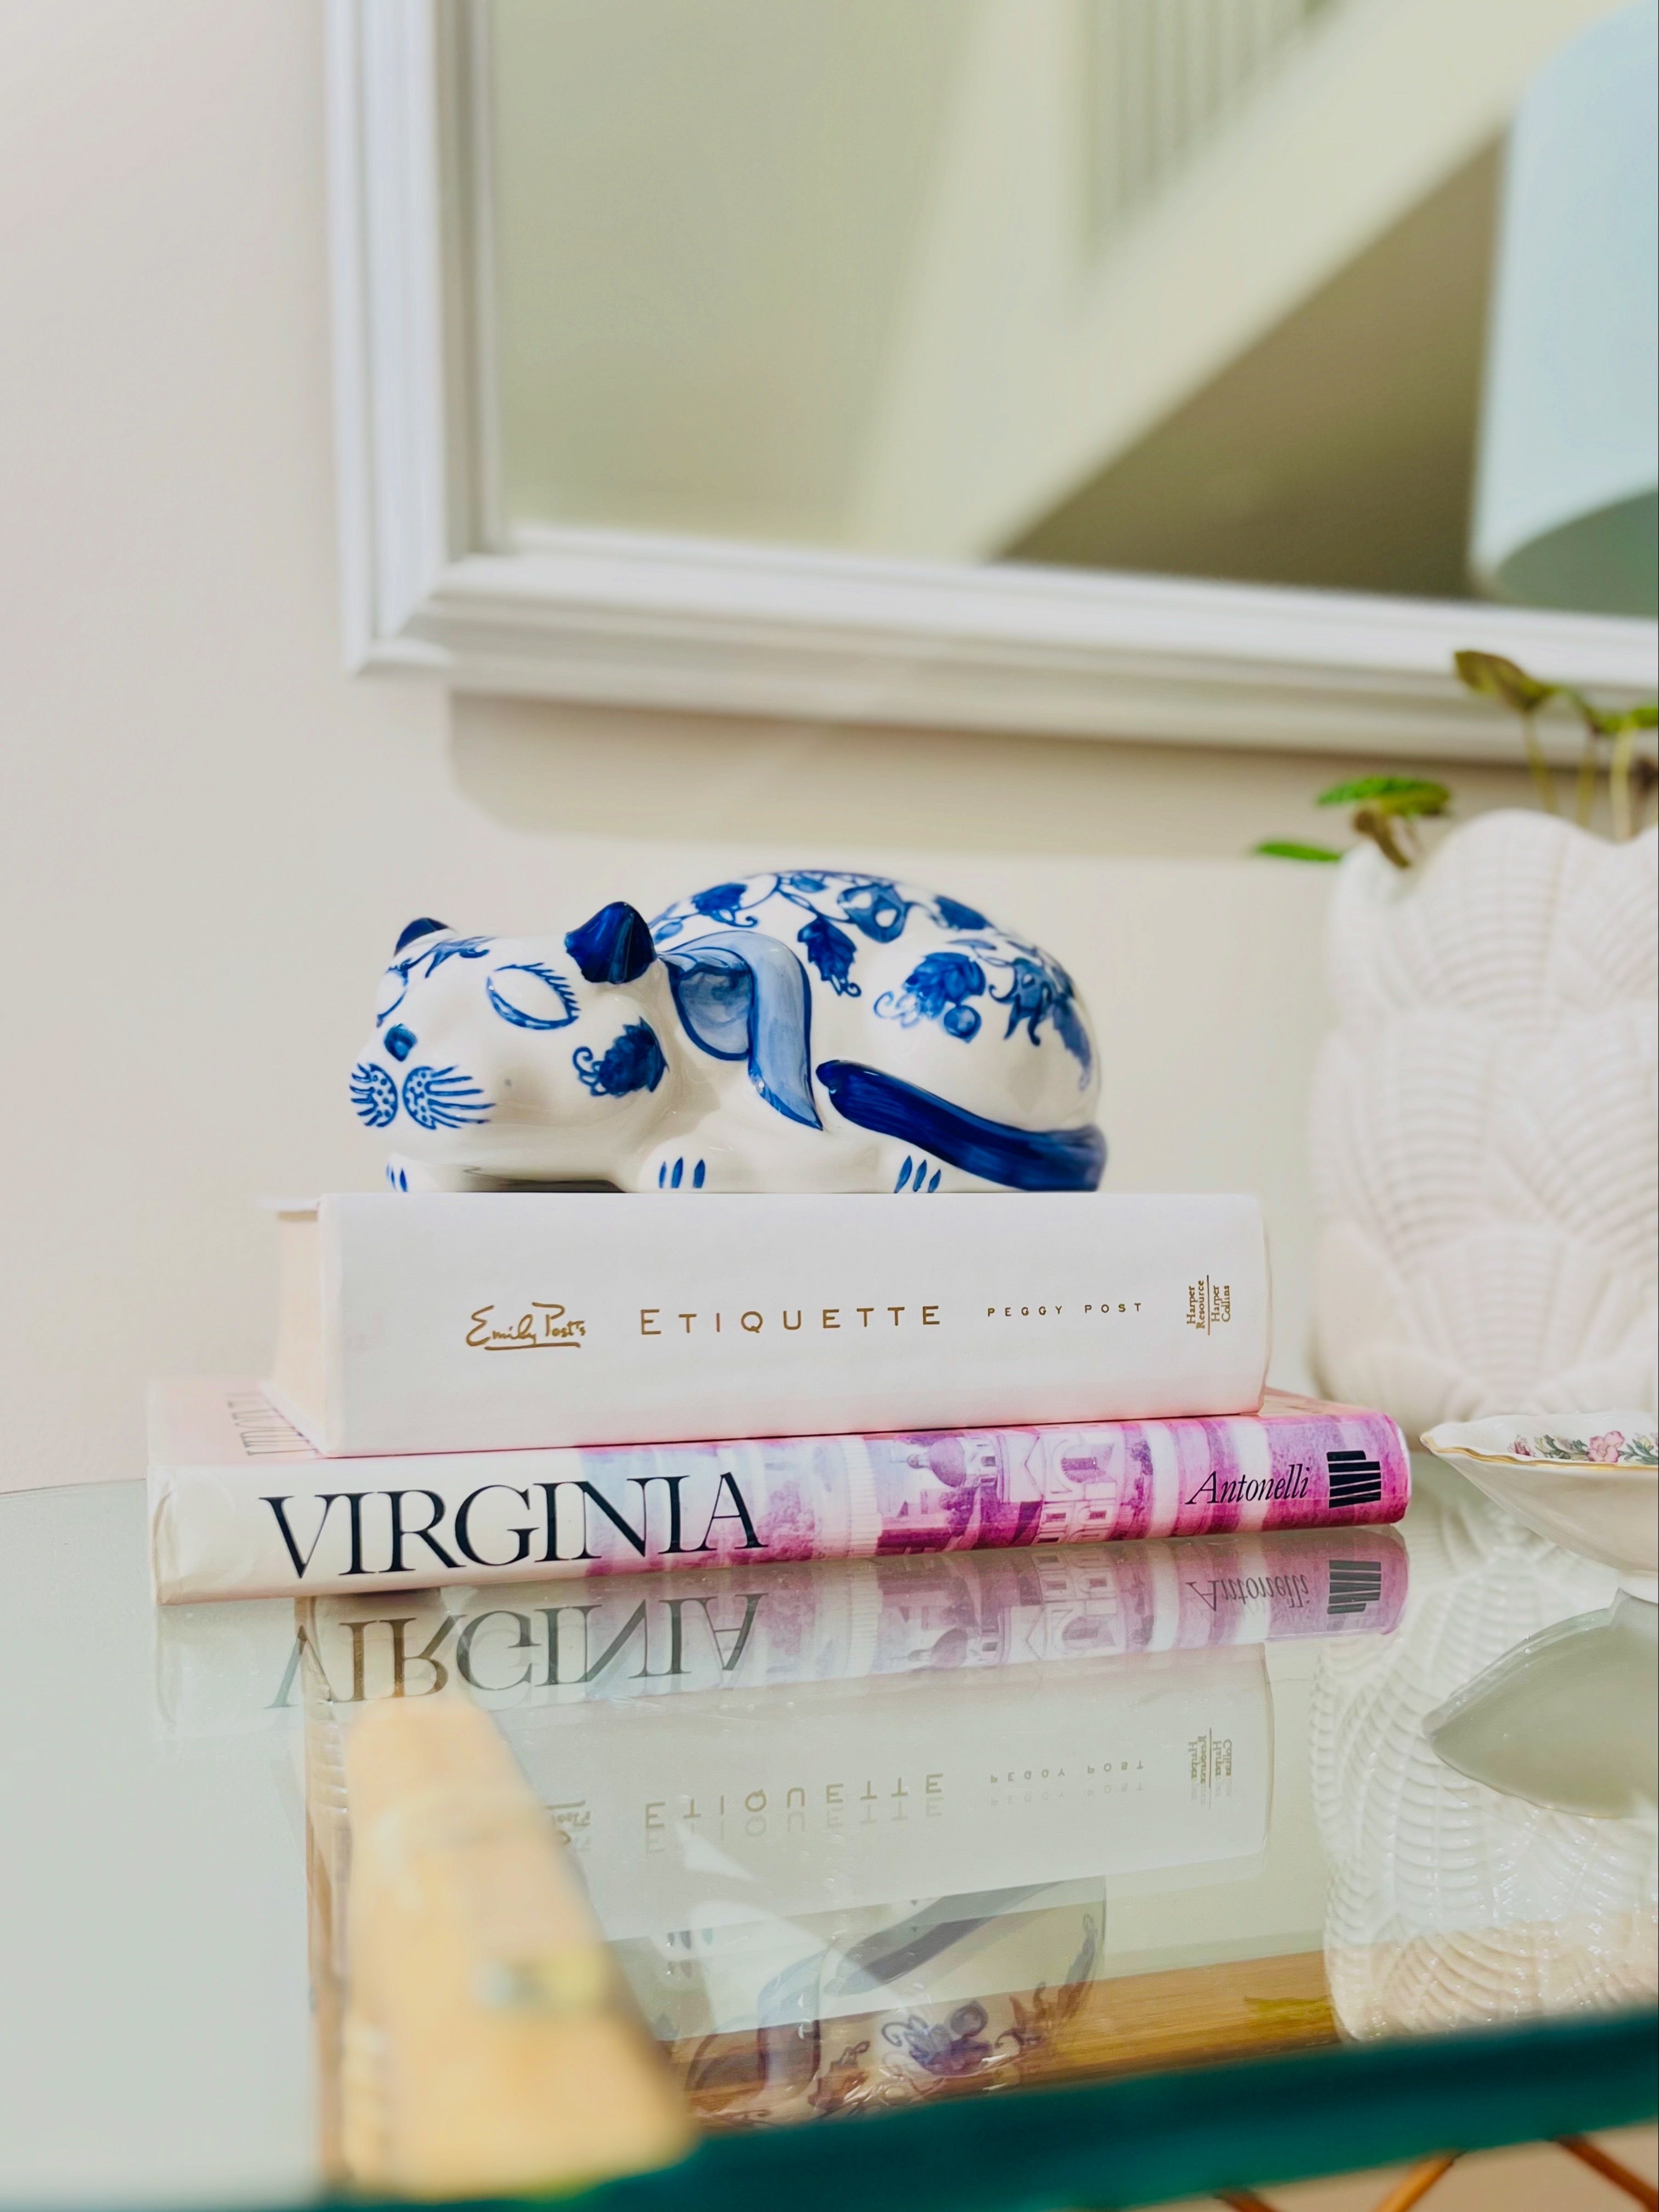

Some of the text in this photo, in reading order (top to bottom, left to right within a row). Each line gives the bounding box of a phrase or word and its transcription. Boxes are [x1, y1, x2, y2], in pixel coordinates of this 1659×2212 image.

[640, 1305, 940, 1335] ETIQUETTE
[987, 1302, 1142, 1317] PEGGY POST
[1186, 1285, 1198, 1324] Harper
[1196, 1280, 1205, 1329] Resource
[1211, 1285, 1222, 1322] Harper
[1221, 1285, 1231, 1322] Collins
[466, 1304, 537, 1346] Emily
[1184, 1463, 1311, 1505] Antonelli
[258, 1471, 770, 1579] VIRGINIA
